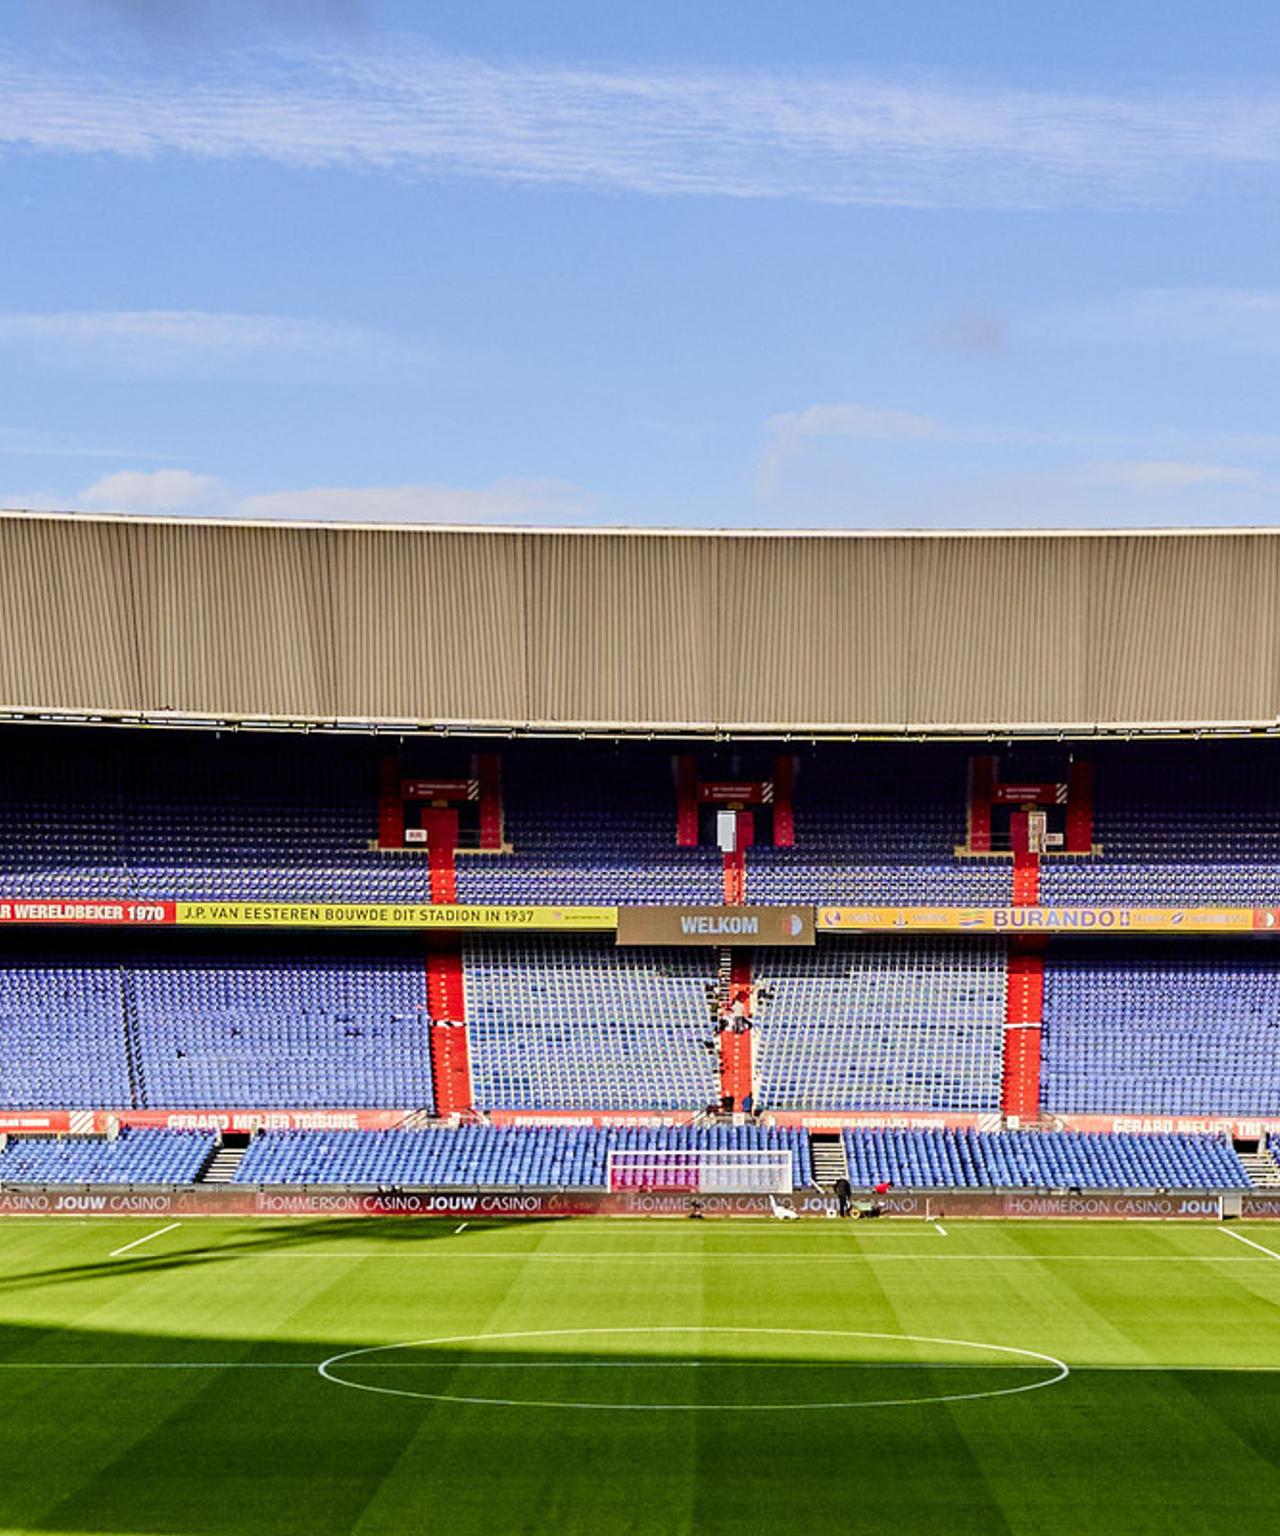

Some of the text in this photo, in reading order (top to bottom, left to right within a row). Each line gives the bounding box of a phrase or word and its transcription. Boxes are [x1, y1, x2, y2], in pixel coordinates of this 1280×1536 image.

[15, 904, 123, 919] WERELDBEKER
[127, 905, 165, 920] 1970
[184, 907, 534, 923] J.P. VAN EESTEREN BOUWDE DIT STADION IN 1937
[993, 910, 1115, 927] BURANDO
[681, 916, 758, 934] WELKOM
[55, 1197, 105, 1210] JOUW
[110, 1196, 170, 1210] CASINO!
[260, 1196, 360, 1210] HOMMERSON
[426, 1197, 478, 1210] JOUW
[481, 1196, 541, 1210] CASINO!
[801, 1197, 850, 1210] JOU
[1009, 1199, 1110, 1214] HOMMERSON
